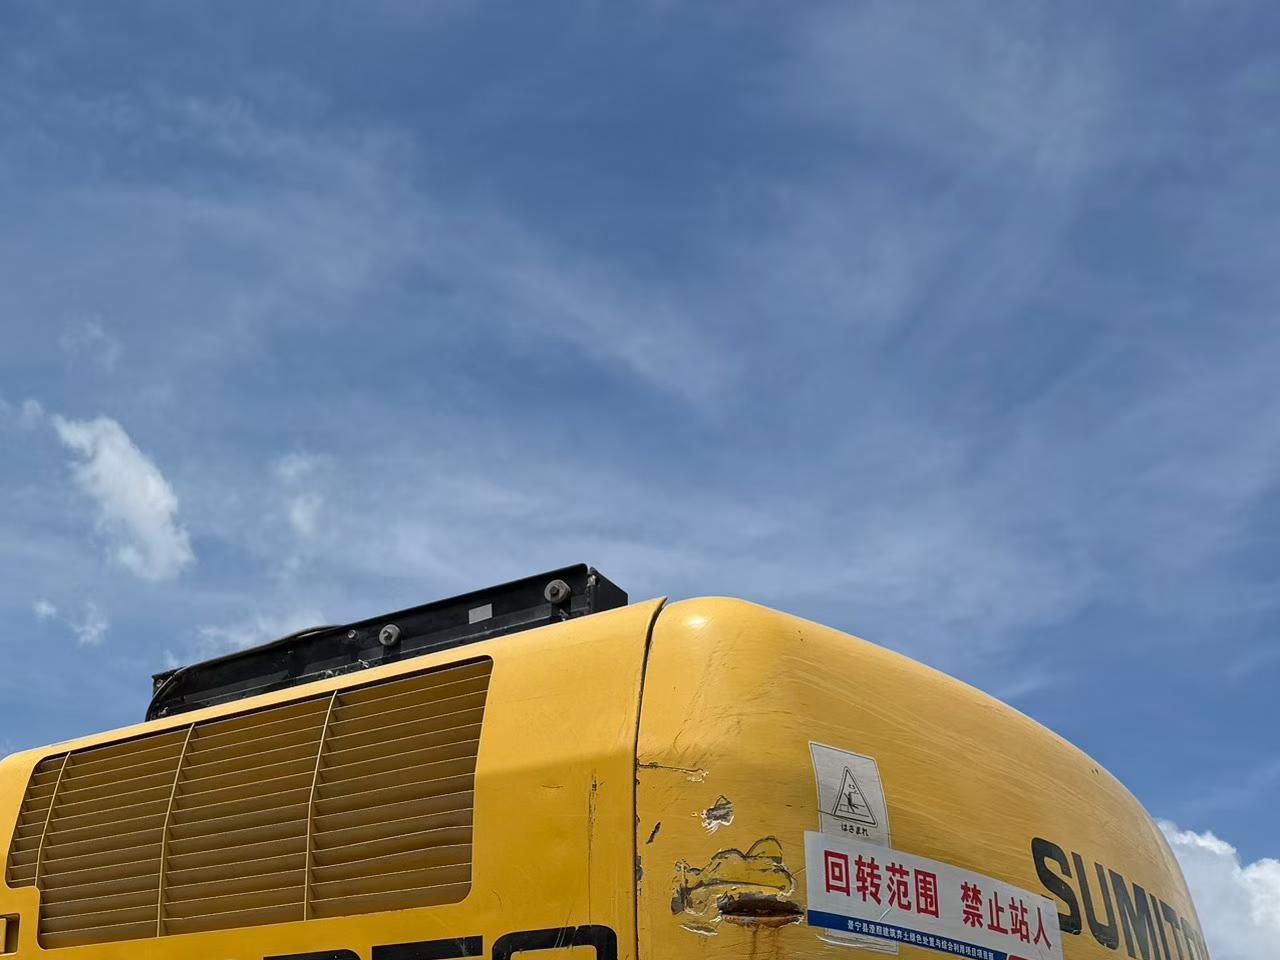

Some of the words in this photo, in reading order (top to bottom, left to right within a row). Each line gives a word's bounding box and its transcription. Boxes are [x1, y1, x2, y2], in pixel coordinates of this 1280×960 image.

[841, 823, 869, 836] はさまれ
[824, 850, 939, 918] 回转范围
[961, 881, 1051, 949] 禁止站人
